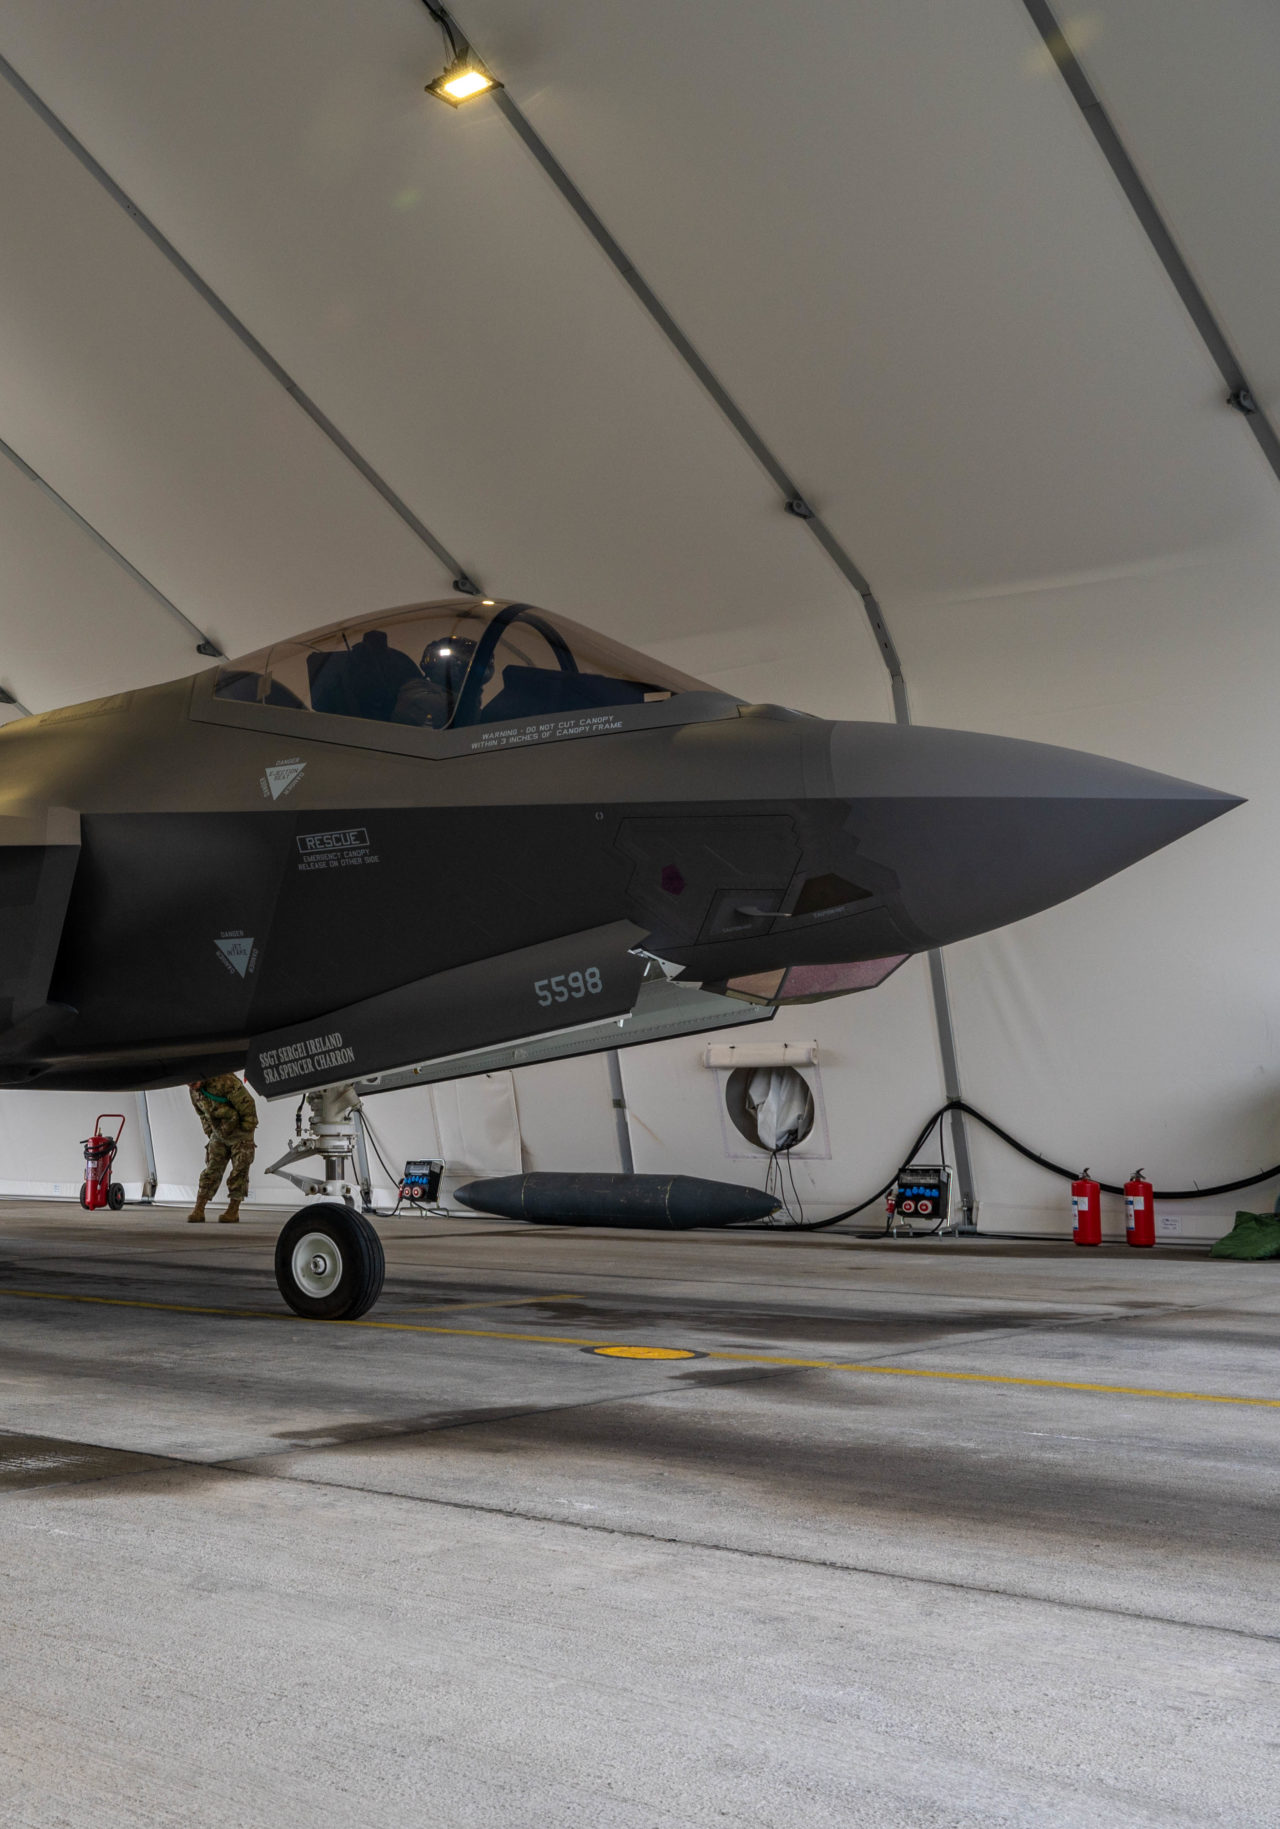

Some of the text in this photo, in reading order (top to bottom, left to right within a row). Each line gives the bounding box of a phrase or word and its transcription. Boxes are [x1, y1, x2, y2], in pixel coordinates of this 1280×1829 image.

[471, 740, 497, 750] WITHIN
[509, 733, 538, 743] INCHES
[556, 726, 590, 736] CANOPY
[593, 721, 623, 731] FRAME
[482, 729, 517, 740] WARNING
[540, 723, 555, 732] NOT
[558, 720, 575, 728] CUT
[580, 715, 614, 725] CANOPY
[305, 832, 360, 850] RESCUE
[298, 862, 328, 871] RELEASE
[341, 858, 362, 866] OTHER
[364, 855, 381, 864] SIDE
[303, 849, 370, 863] EMERGENCY CANOPY
[534, 966, 603, 1007] 5598
[259, 1032, 343, 1068] SSGT SERGEI IRELAND
[263, 1047, 355, 1084] SRA SPENCER CHARRON
